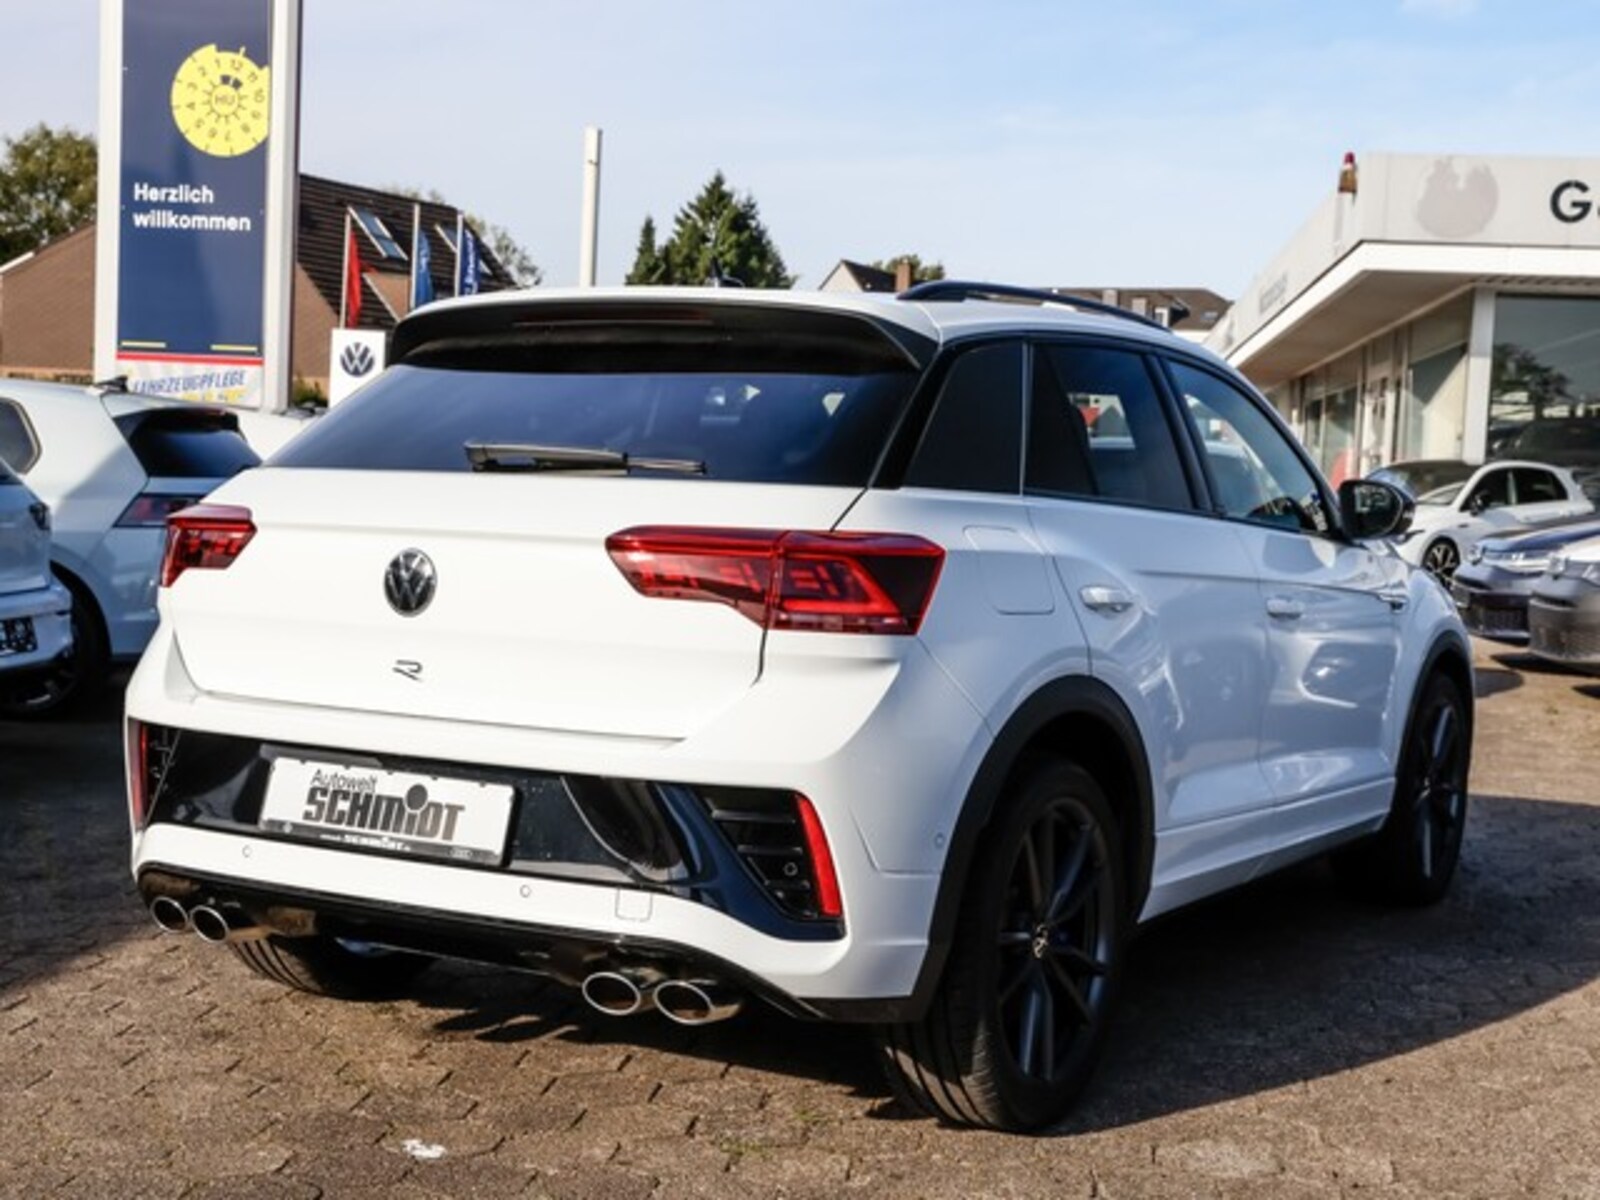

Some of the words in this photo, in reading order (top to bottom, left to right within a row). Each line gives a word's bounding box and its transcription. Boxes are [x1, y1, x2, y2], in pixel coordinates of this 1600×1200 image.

[134, 182, 214, 203] Herzlich
[1550, 180, 1600, 224] G
[133, 209, 251, 231] willkommen
[310, 768, 377, 793] Autowelt
